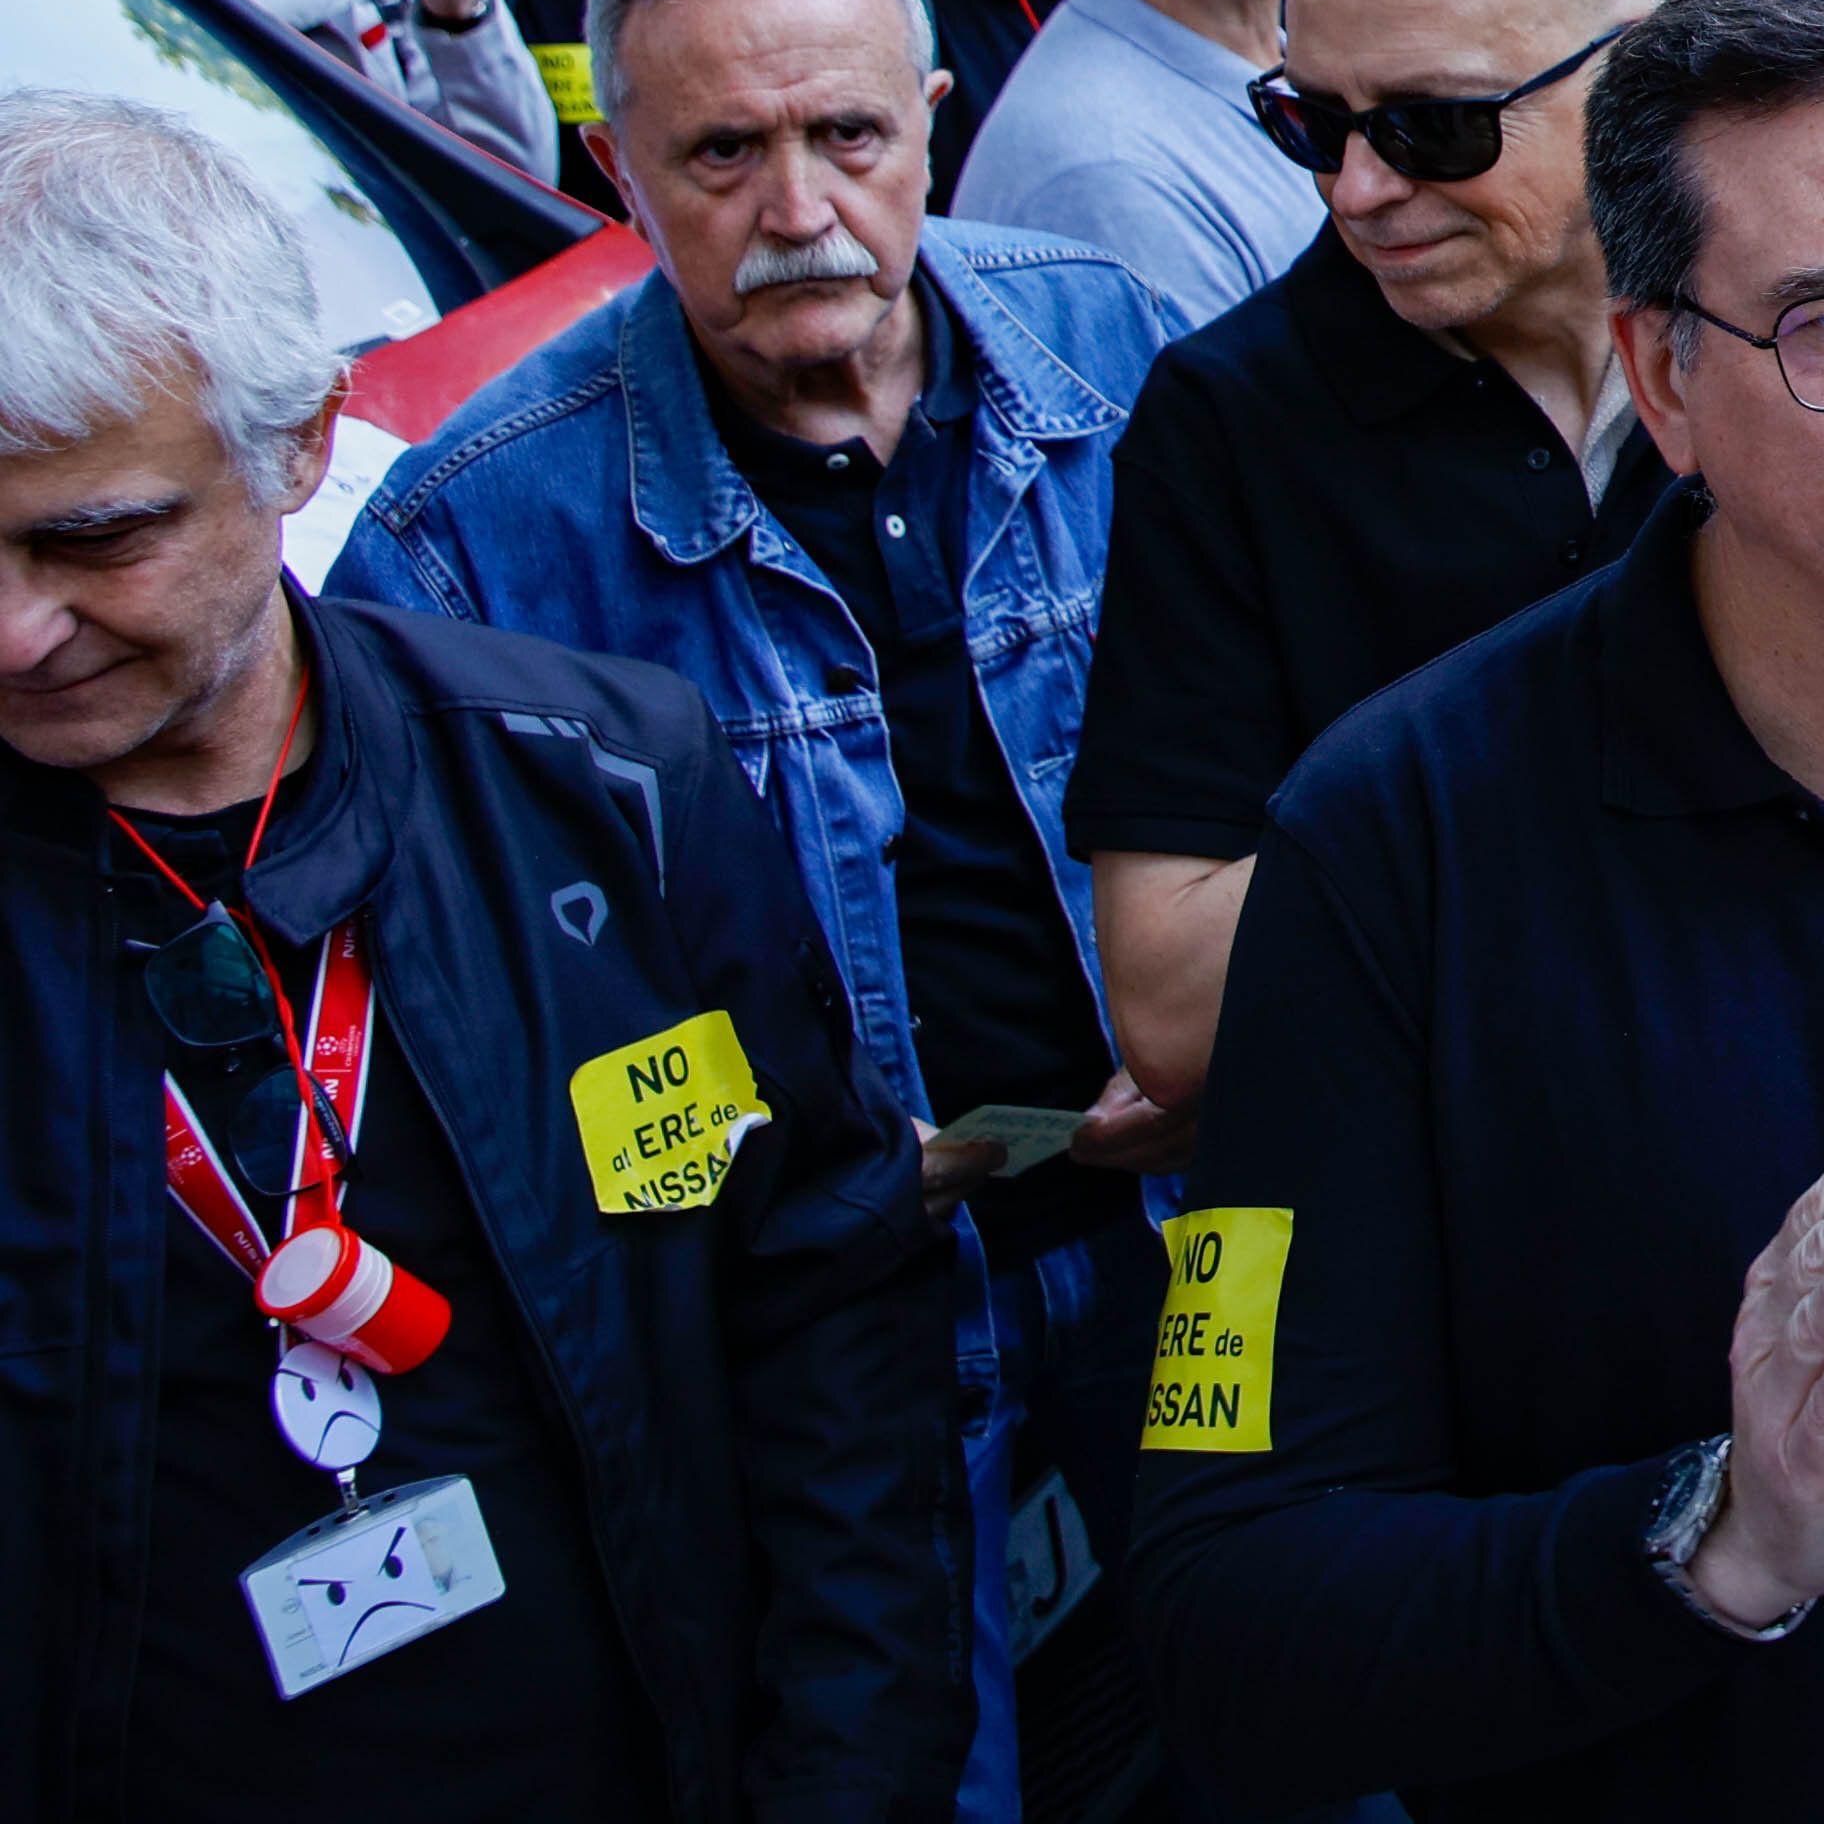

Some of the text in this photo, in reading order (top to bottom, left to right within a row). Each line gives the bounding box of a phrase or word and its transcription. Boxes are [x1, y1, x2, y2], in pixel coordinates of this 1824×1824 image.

[626, 1045, 690, 1104] NO
[612, 1102, 740, 1174] al ERE de
[1176, 1230, 1223, 1286] NO
[1158, 1312, 1244, 1358] ERE de
